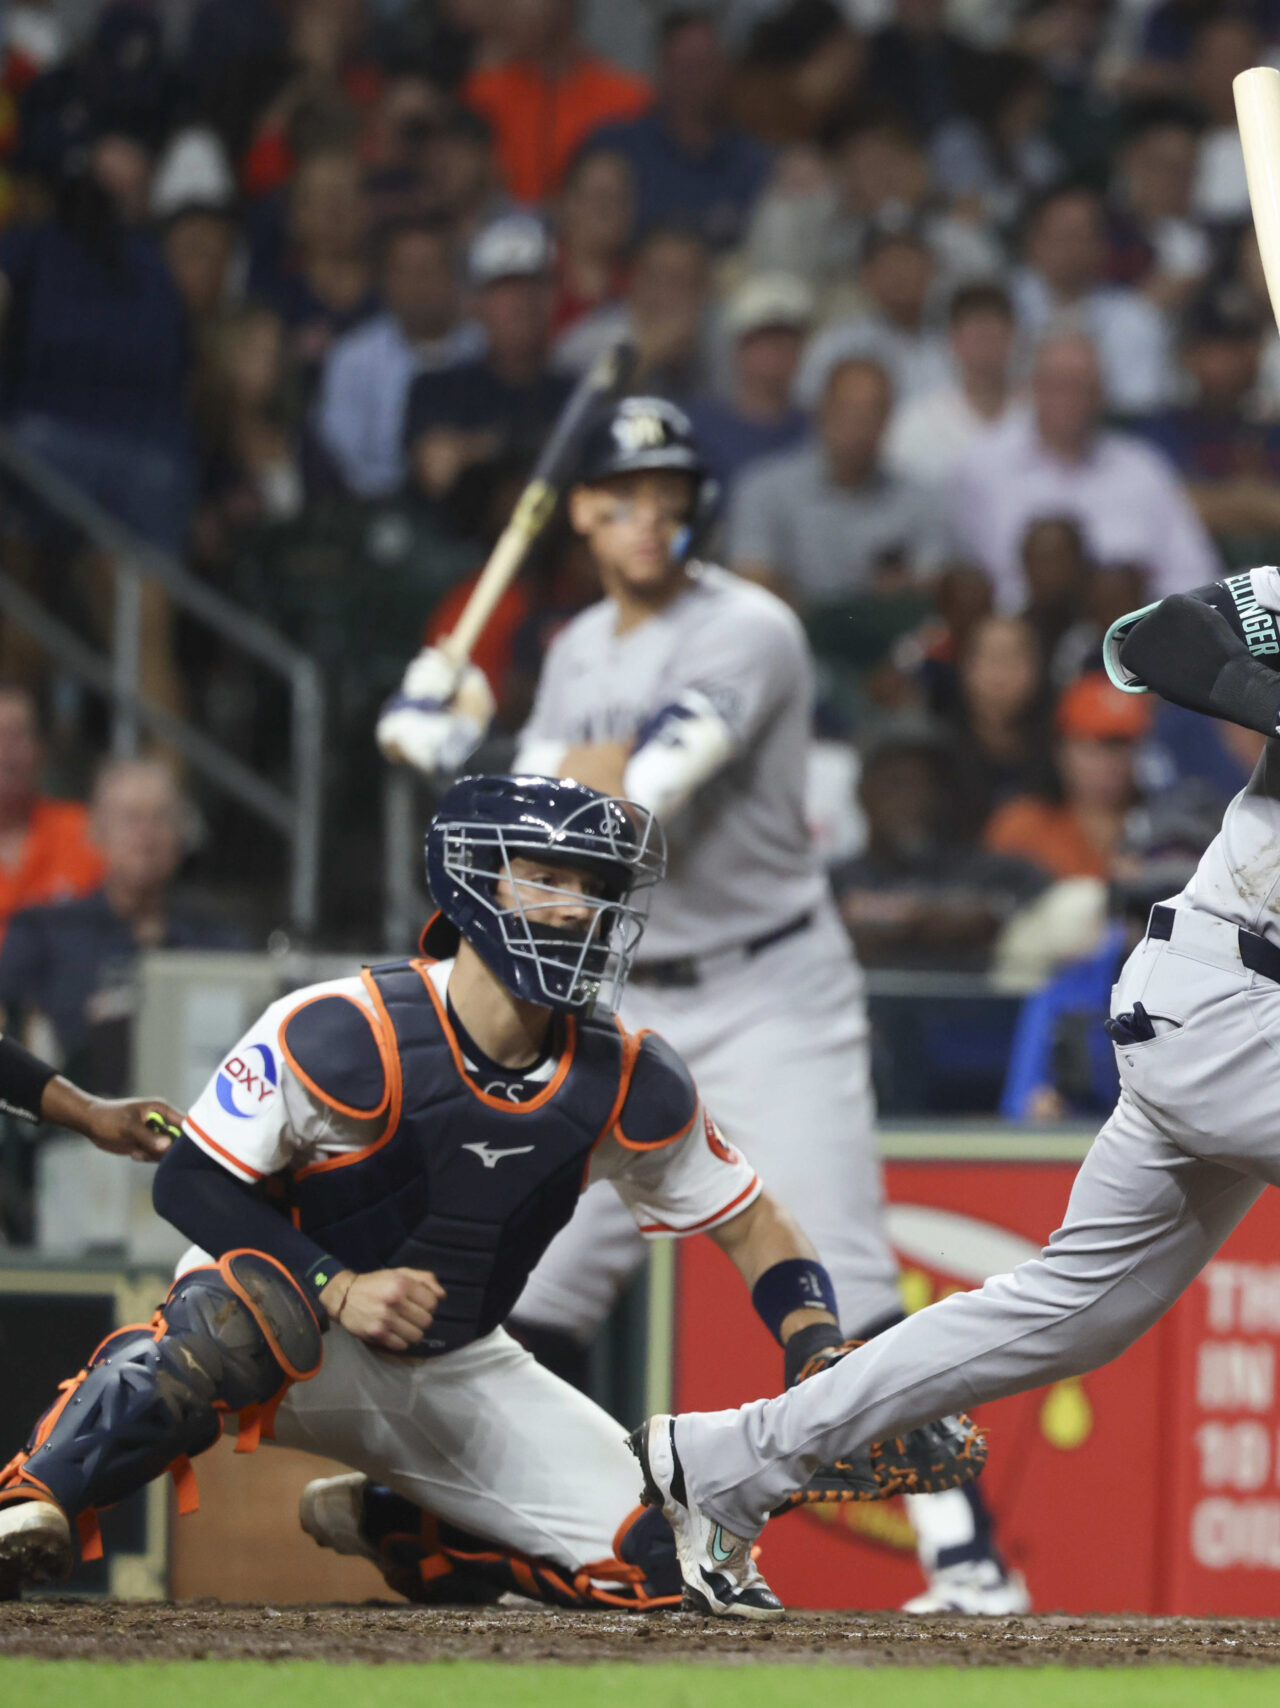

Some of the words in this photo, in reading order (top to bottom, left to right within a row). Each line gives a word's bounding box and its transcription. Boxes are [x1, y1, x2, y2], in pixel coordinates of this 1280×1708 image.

[224, 1057, 275, 1102] OXY
[1197, 1340, 1275, 1413] IN
[1194, 1420, 1270, 1490] 10
